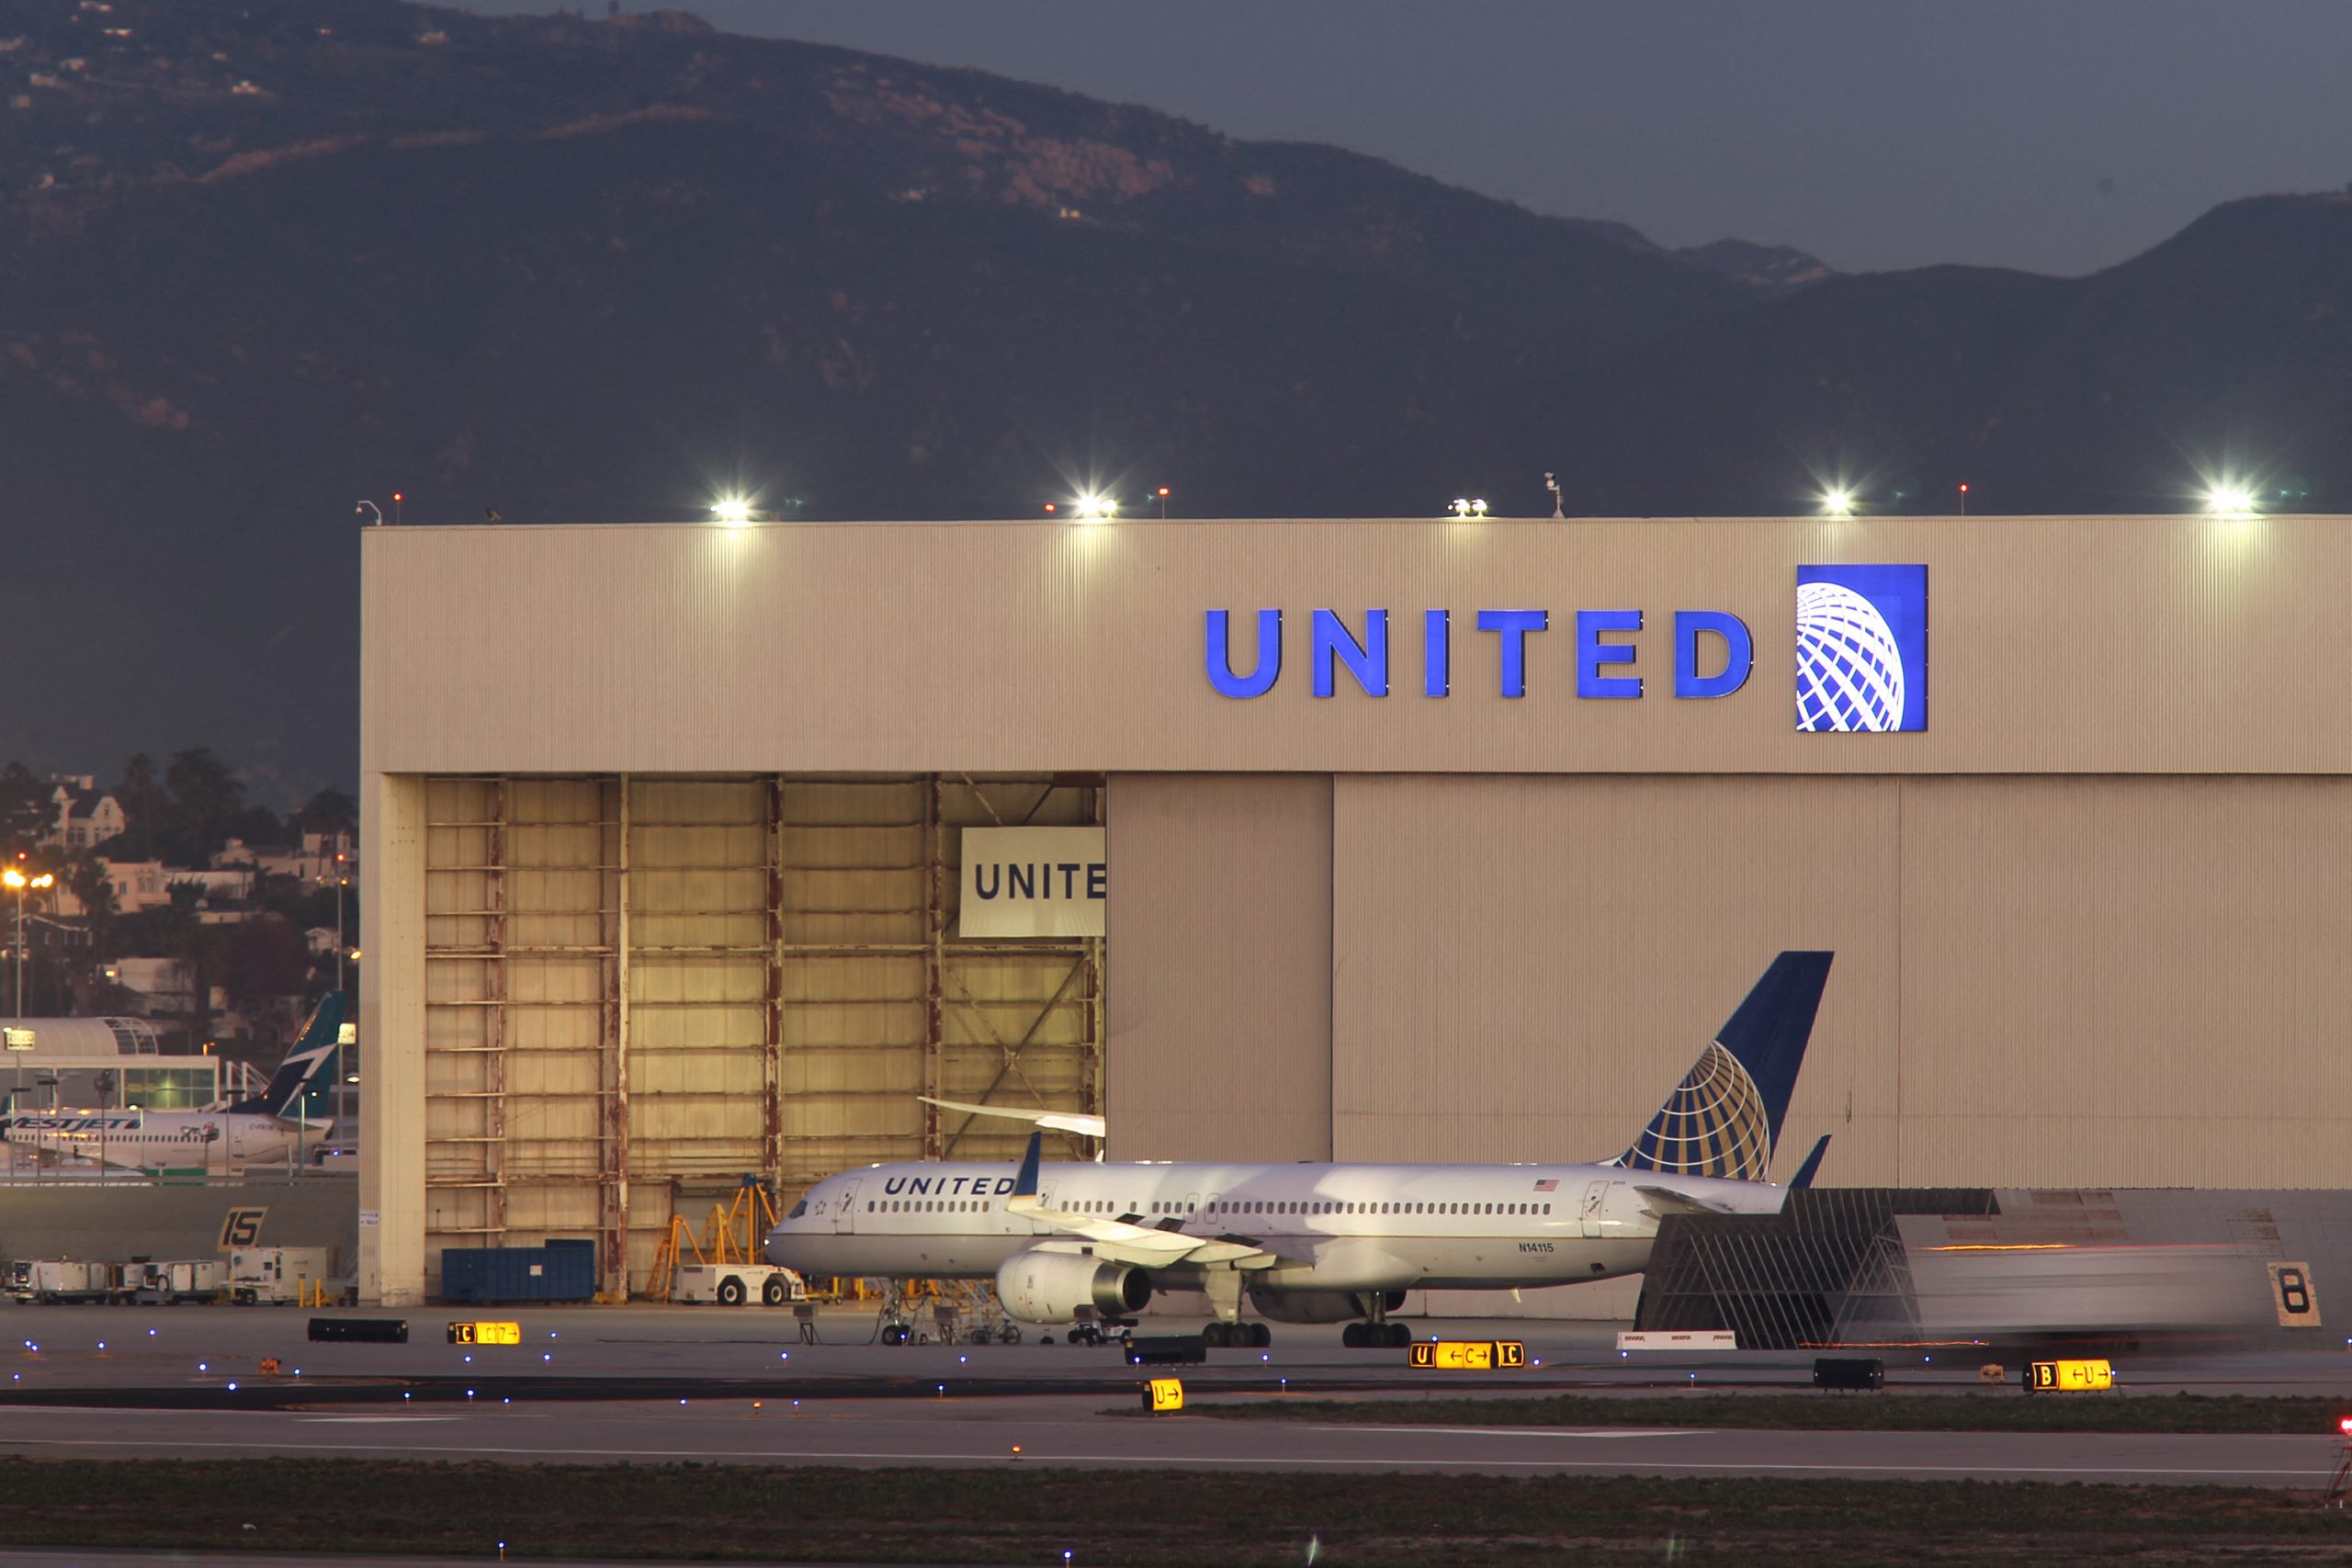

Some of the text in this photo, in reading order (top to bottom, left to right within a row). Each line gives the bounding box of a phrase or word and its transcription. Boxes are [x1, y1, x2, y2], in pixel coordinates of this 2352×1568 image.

[1205, 608, 1754, 698] UNITED
[975, 863, 1106, 900] UNITE
[884, 1177, 1016, 1195] UNITED
[222, 1211, 265, 1247] 15
[1518, 1242, 1555, 1253] N14115
[2278, 1268, 2311, 1314] 8
[462, 1325, 471, 1342] C
[1417, 1346, 1518, 1364] U C C
[2040, 1365, 2094, 1386] B U
[1154, 1385, 1166, 1404] U
